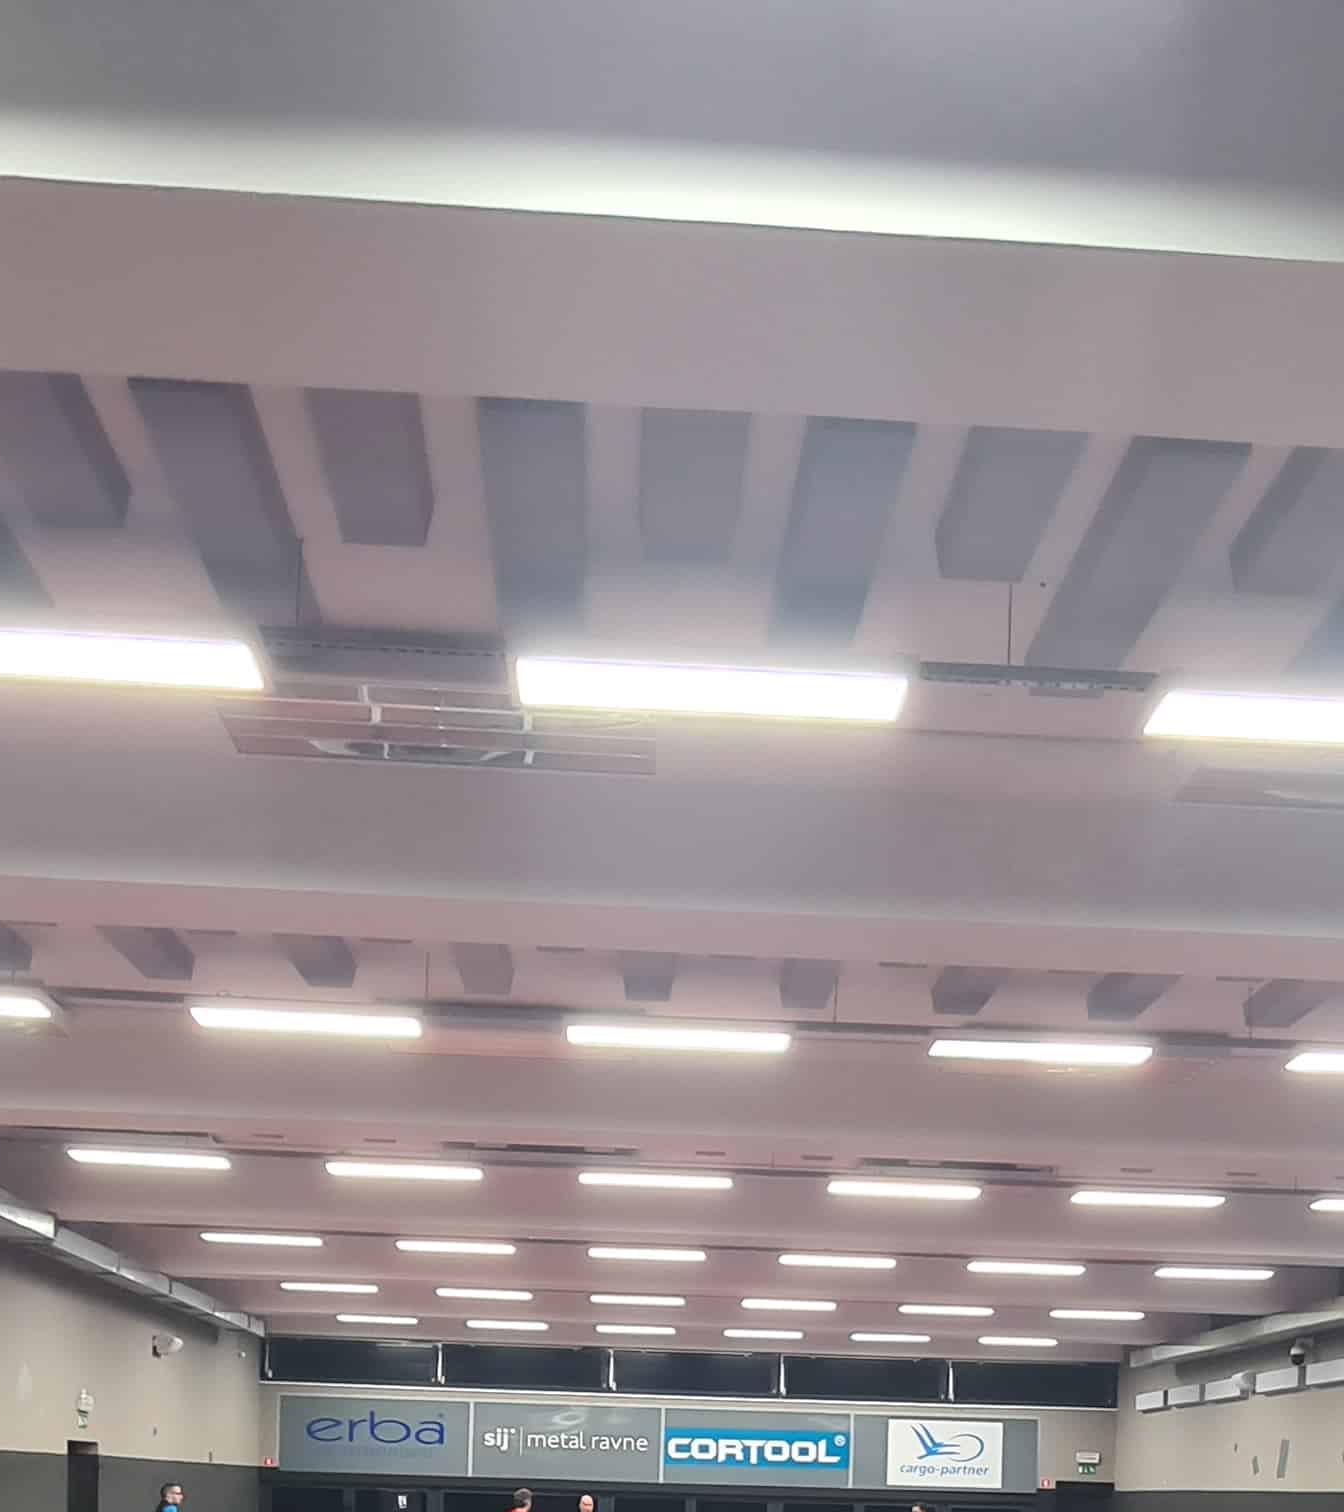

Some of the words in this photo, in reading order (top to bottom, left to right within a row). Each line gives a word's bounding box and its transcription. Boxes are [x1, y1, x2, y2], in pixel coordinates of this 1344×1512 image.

[306, 1410, 446, 1446] erba
[527, 1430, 586, 1451] metal
[591, 1433, 650, 1452] ravne
[667, 1437, 841, 1465] CORTOOL
[899, 1463, 991, 1477] cargo-partner
